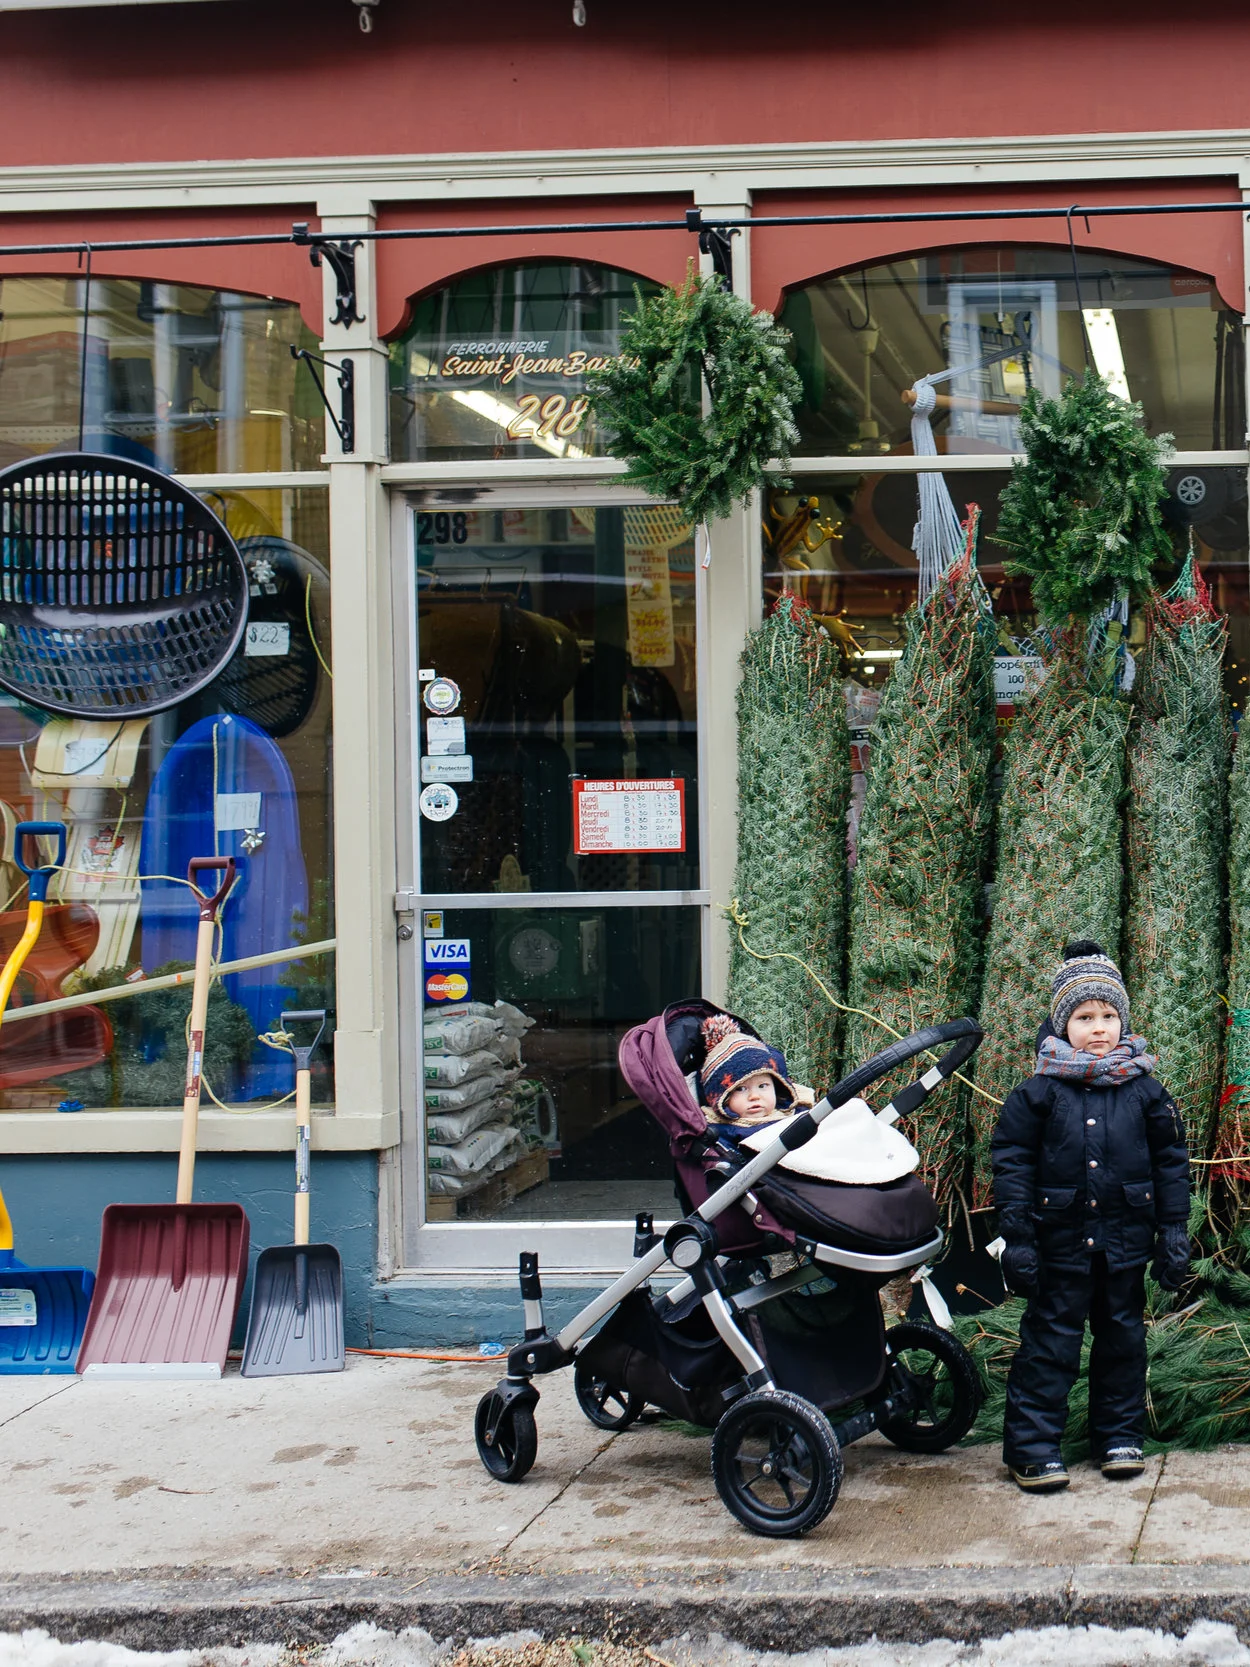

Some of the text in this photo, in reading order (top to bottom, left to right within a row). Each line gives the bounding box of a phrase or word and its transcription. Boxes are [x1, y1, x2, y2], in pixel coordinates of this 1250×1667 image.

[447, 340, 549, 355] FERRONNERIE
[506, 394, 590, 441] 298
[417, 511, 468, 544] 298
[584, 781, 675, 791] HEURES D'OUVERTURES
[581, 794, 598, 803] Lundi
[581, 825, 610, 833] Vendredi
[581, 840, 614, 848] Dimanche
[430, 944, 468, 958] VISA
[427, 982, 468, 991] MasterCard
